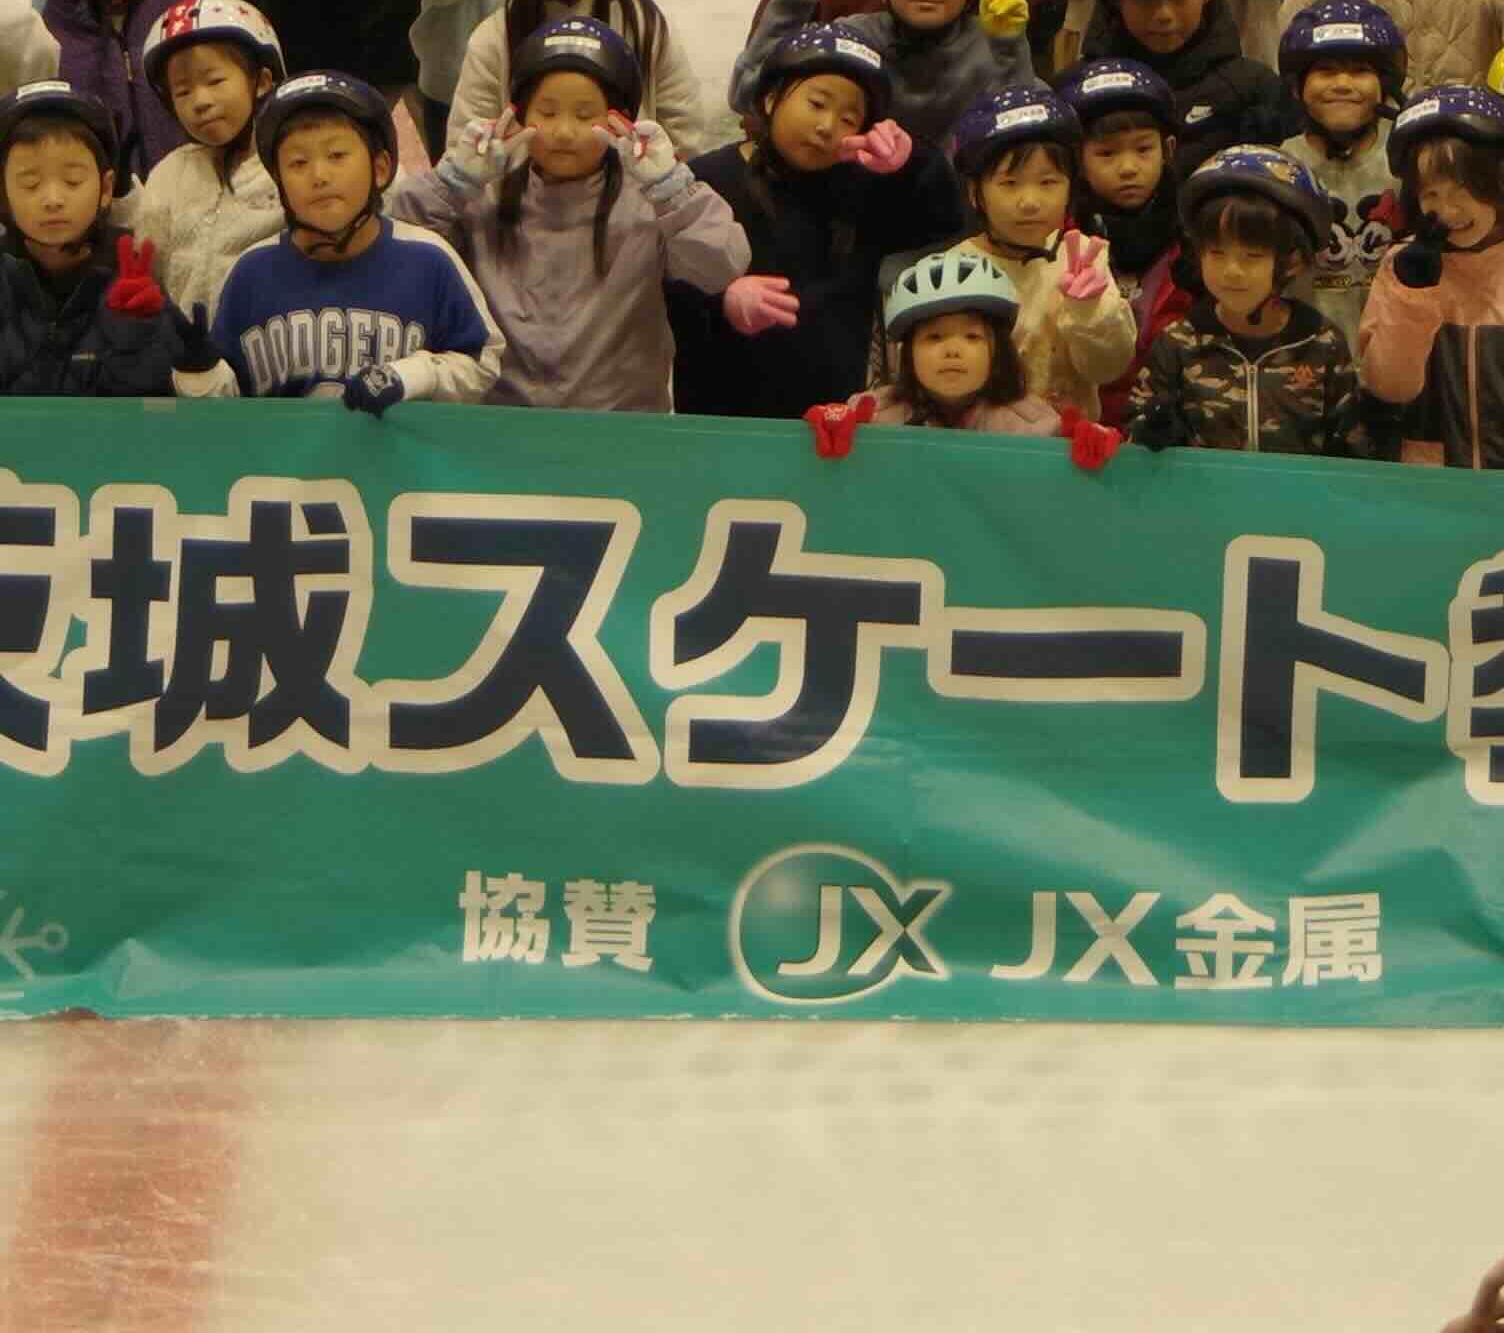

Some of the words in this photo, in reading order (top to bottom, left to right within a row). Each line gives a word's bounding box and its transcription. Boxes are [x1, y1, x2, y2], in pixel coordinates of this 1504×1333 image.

[458, 869, 658, 973] 協賛
[777, 881, 952, 979] JX
[992, 890, 1384, 990] JX金属
